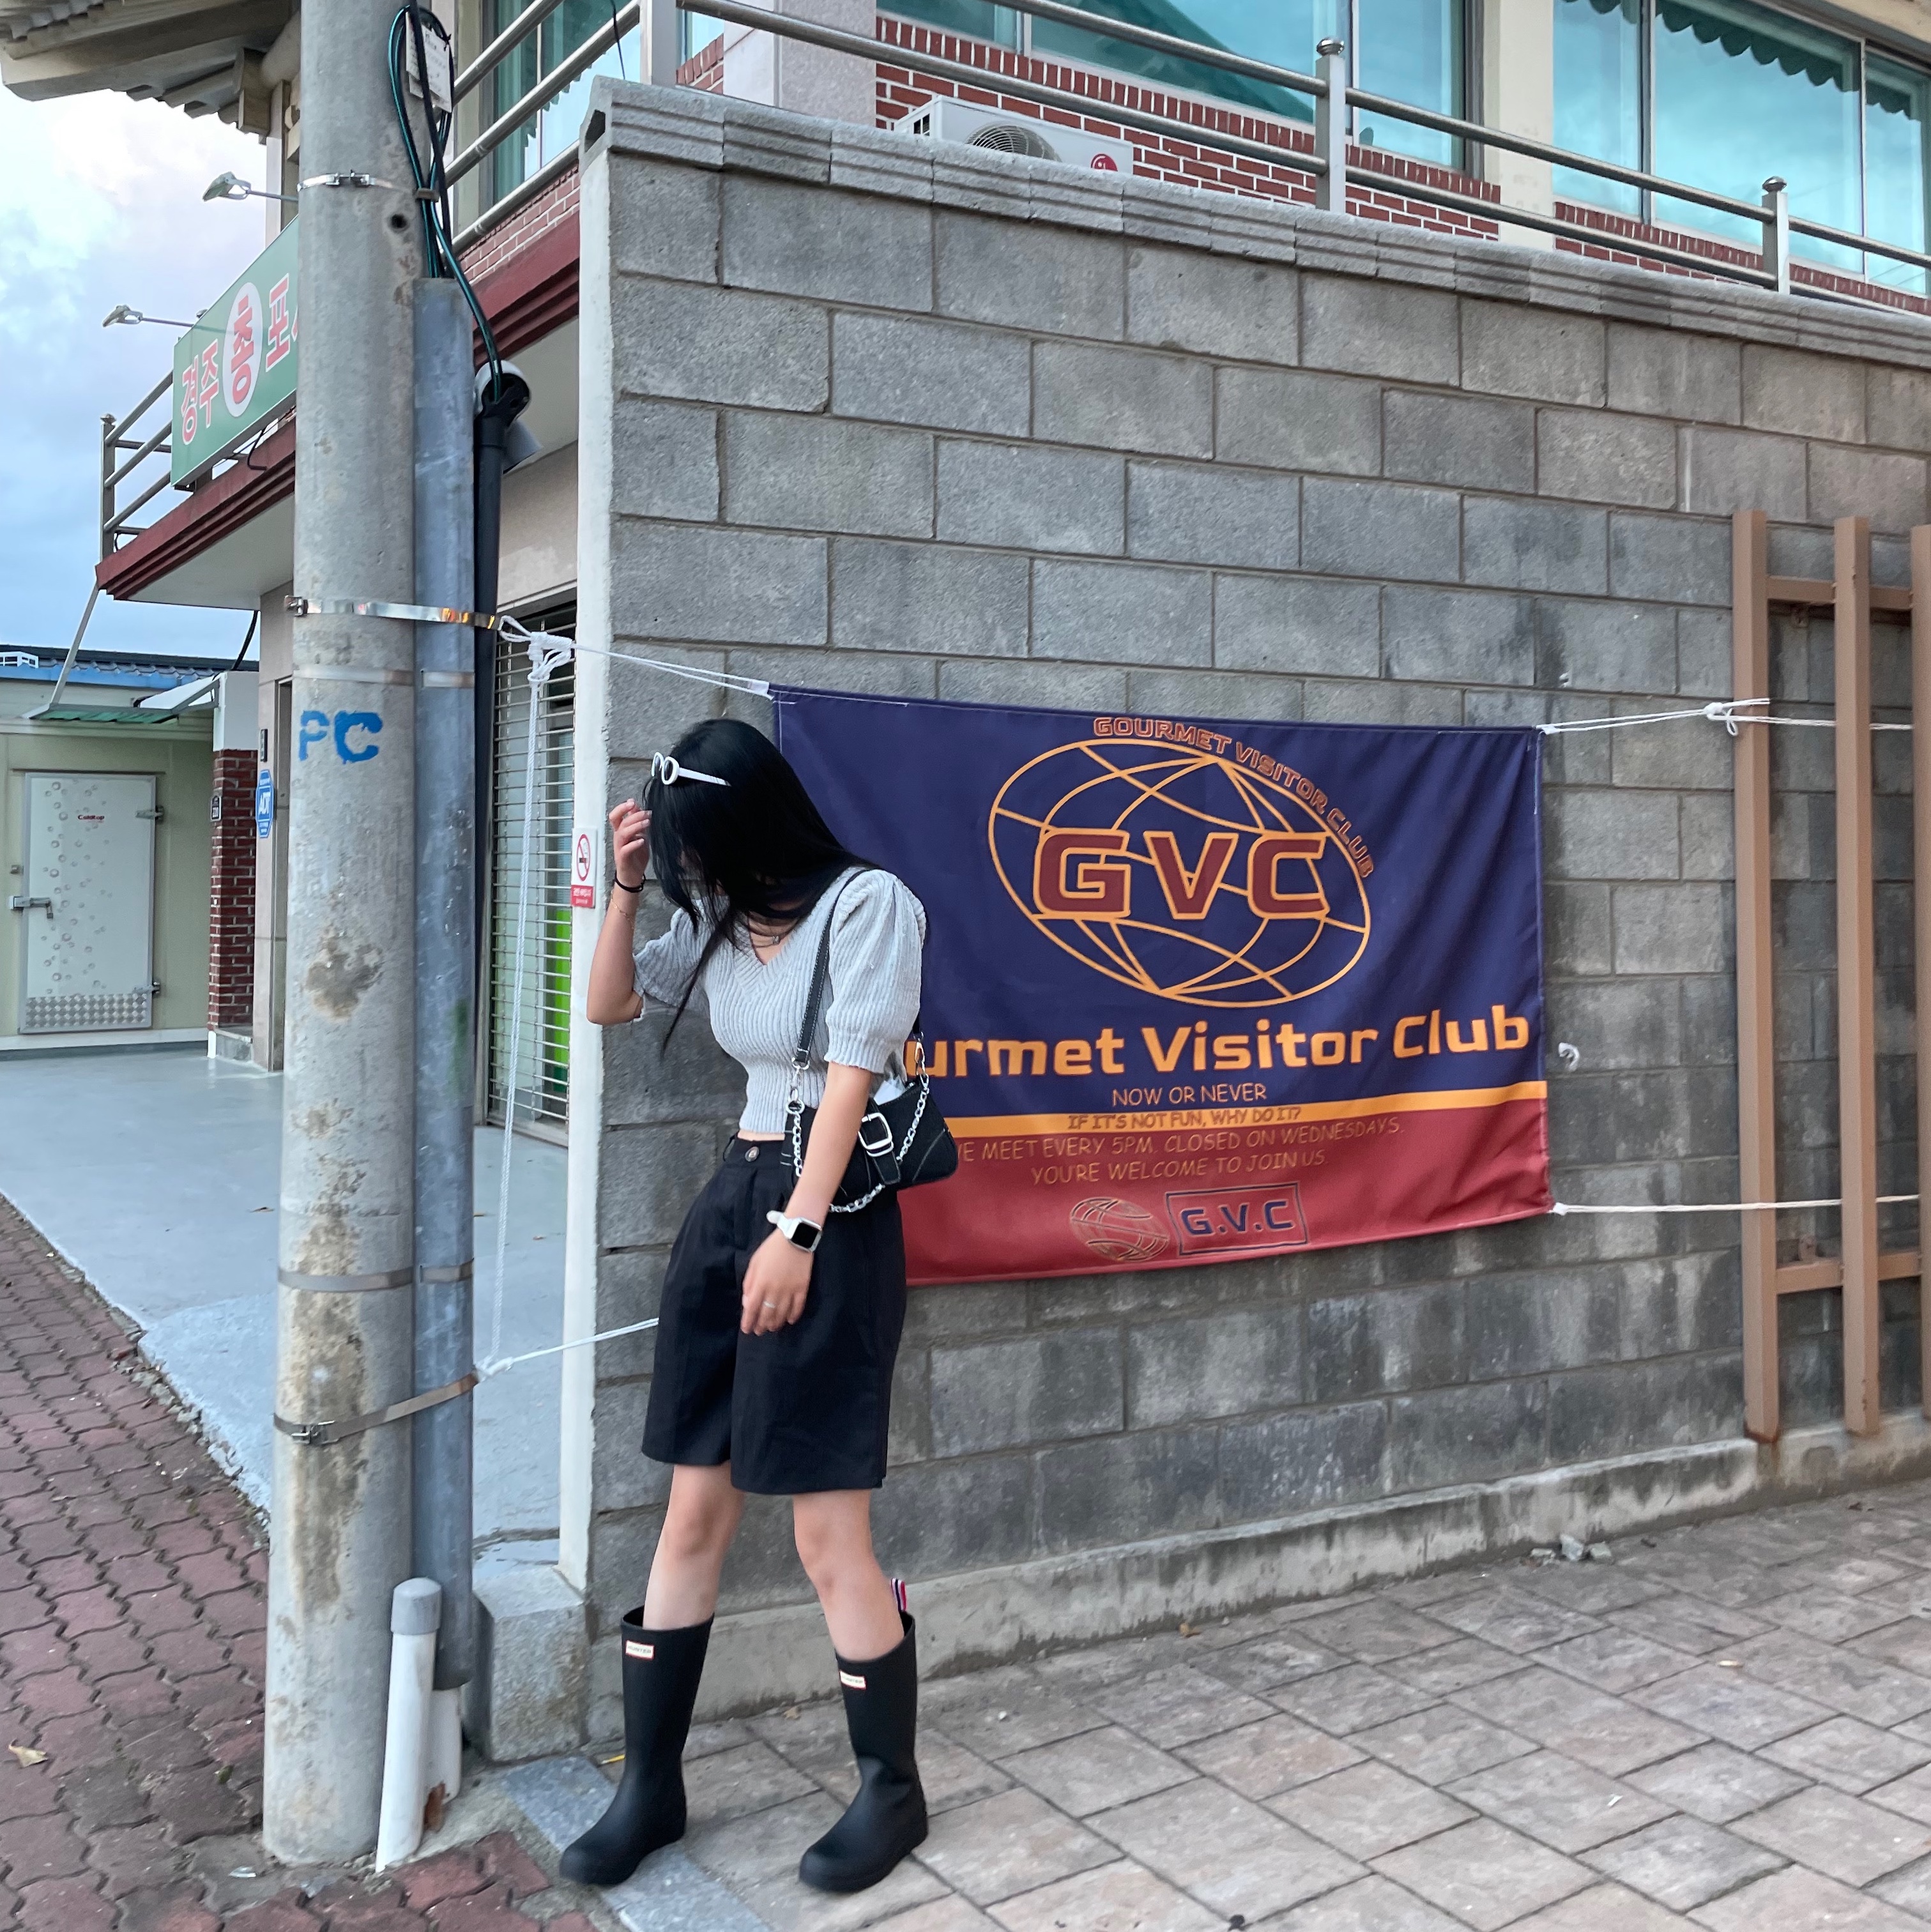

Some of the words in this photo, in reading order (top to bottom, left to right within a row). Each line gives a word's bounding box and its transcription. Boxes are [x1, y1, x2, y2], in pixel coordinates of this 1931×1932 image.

[181, 338, 219, 445] 경주
[298, 710, 383, 764] PC
[1093, 717, 1232, 754] GOURMET
[1235, 741, 1328, 814] VISITOR
[1327, 807, 1374, 878] CLUB
[1034, 828, 1329, 920] GVC
[904, 1026, 1126, 1077] urmet
[1141, 1020, 1378, 1072] Visitor
[1393, 1004, 1530, 1060] Club
[1067, 1114, 1088, 1130] IF
[1131, 1113, 1164, 1129] NOT
[1170, 1110, 1206, 1128] FUN,
[1212, 1107, 1246, 1125] WHY
[1252, 1107, 1273, 1123] DO
[1277, 1105, 1302, 1120] IT?
[1111, 1088, 1163, 1107] NOW
[1168, 1086, 1195, 1104] OR
[1200, 1083, 1267, 1103] NEVER
[981, 1139, 1039, 1160] MEET
[1042, 1137, 1106, 1158] EVERY
[1164, 1132, 1241, 1153] CLOSED
[1246, 1129, 1276, 1148] ON
[1107, 1157, 1209, 1181] WELCOME
[1216, 1155, 1242, 1174] TO
[1246, 1151, 1299, 1172] JOIN
[1180, 1198, 1295, 1238] G.V.C
